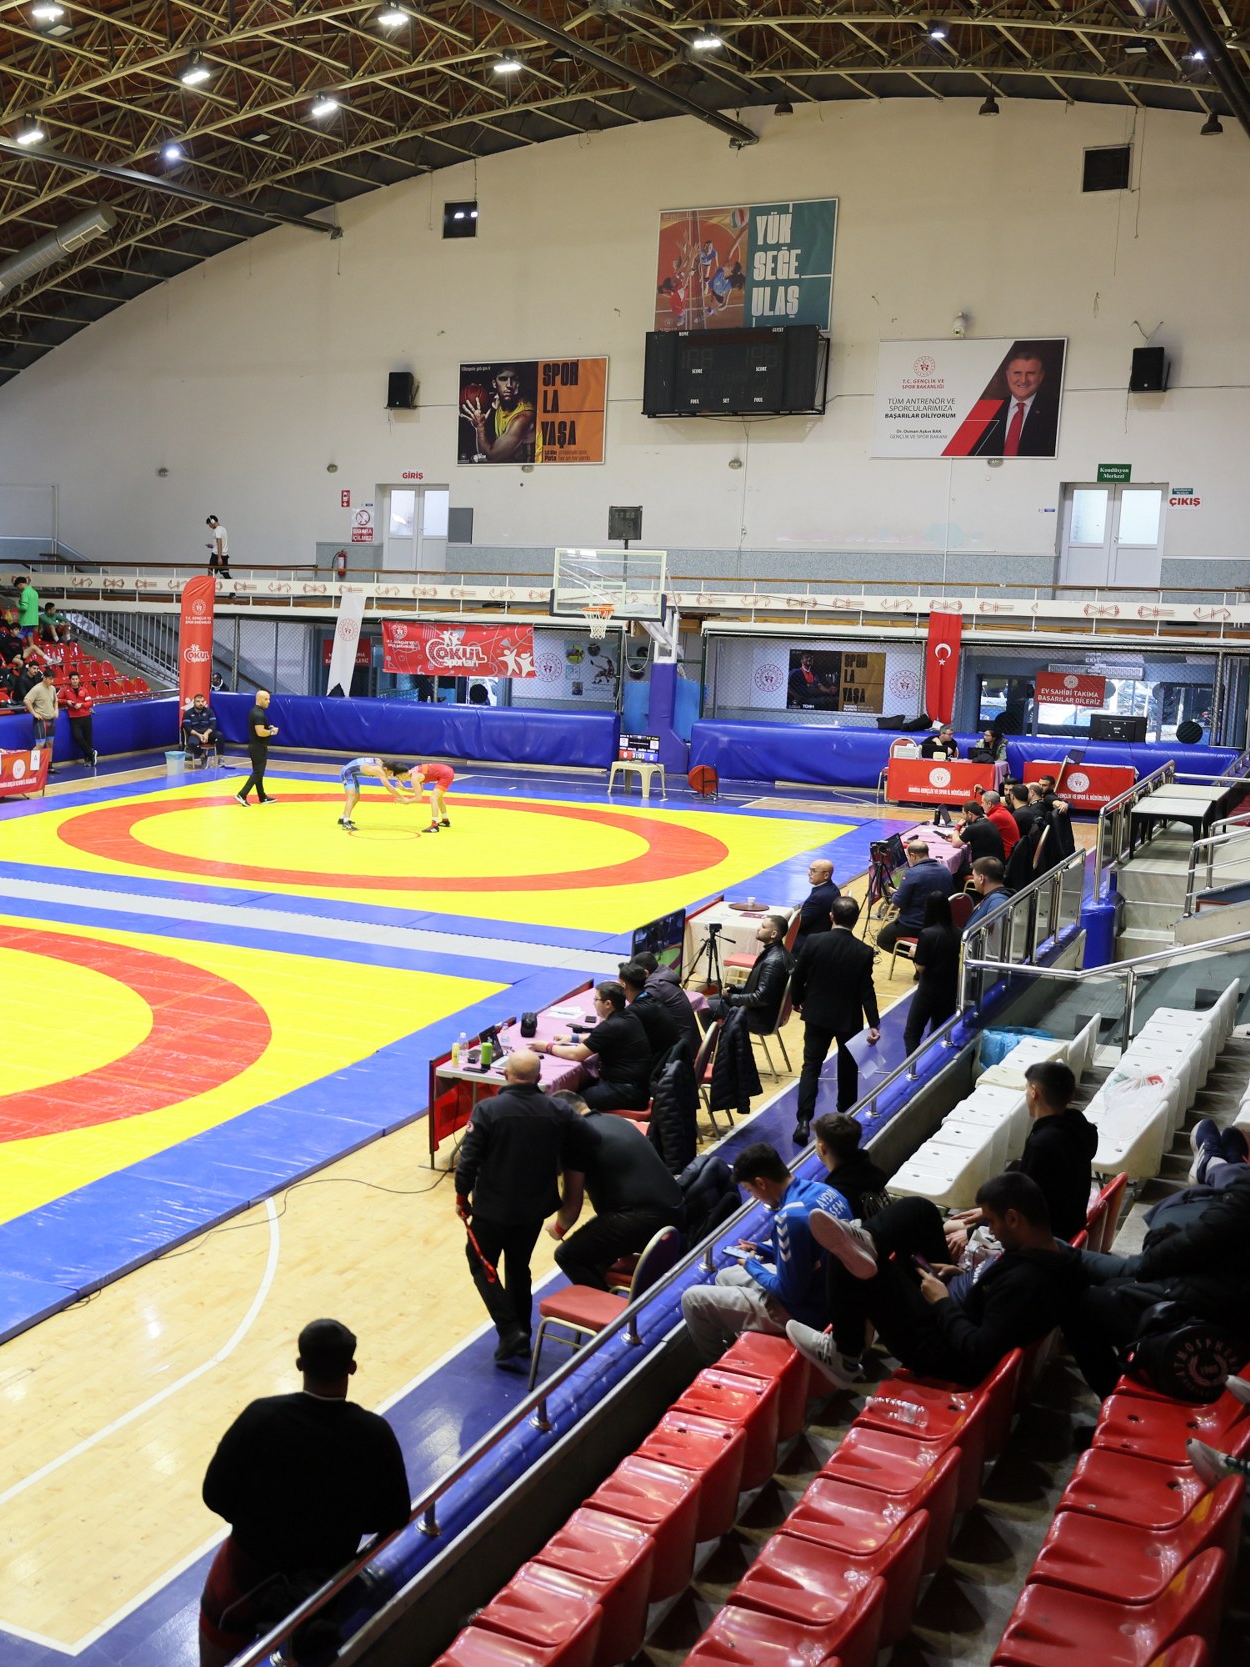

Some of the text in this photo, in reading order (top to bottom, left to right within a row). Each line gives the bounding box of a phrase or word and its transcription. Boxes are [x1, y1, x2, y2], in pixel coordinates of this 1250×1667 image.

[756, 212, 792, 245] YÜK
[753, 247, 801, 281] SEĞE
[752, 286, 799, 318] ULAŞ
[543, 390, 560, 414] LA
[541, 420, 577, 449] YAŞA
[402, 471, 424, 480] GİRİŞ
[1169, 497, 1202, 507] ÇIKIŞ
[816, 1189, 839, 1210] AYDIN
[829, 1200, 847, 1219] SEM
